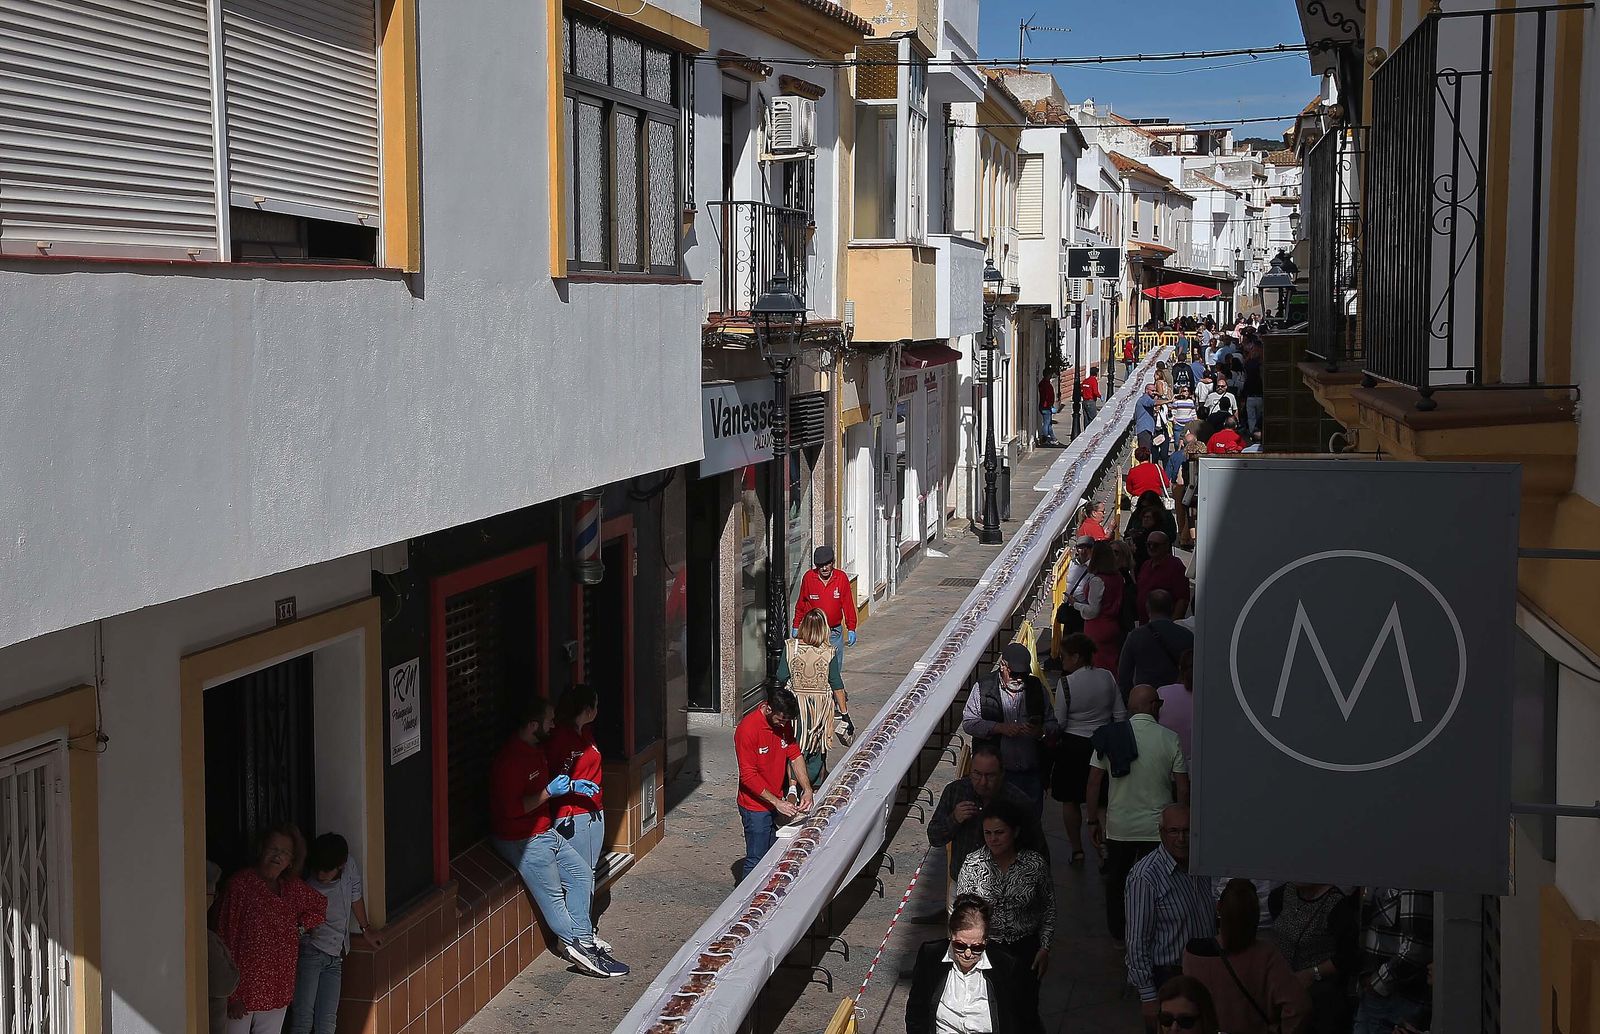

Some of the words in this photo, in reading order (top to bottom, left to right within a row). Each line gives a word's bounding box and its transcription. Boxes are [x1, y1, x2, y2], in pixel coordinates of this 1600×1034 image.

[710, 397, 775, 439] Vanessa
[1271, 599, 1422, 722] M
[393, 664, 417, 702] RM
